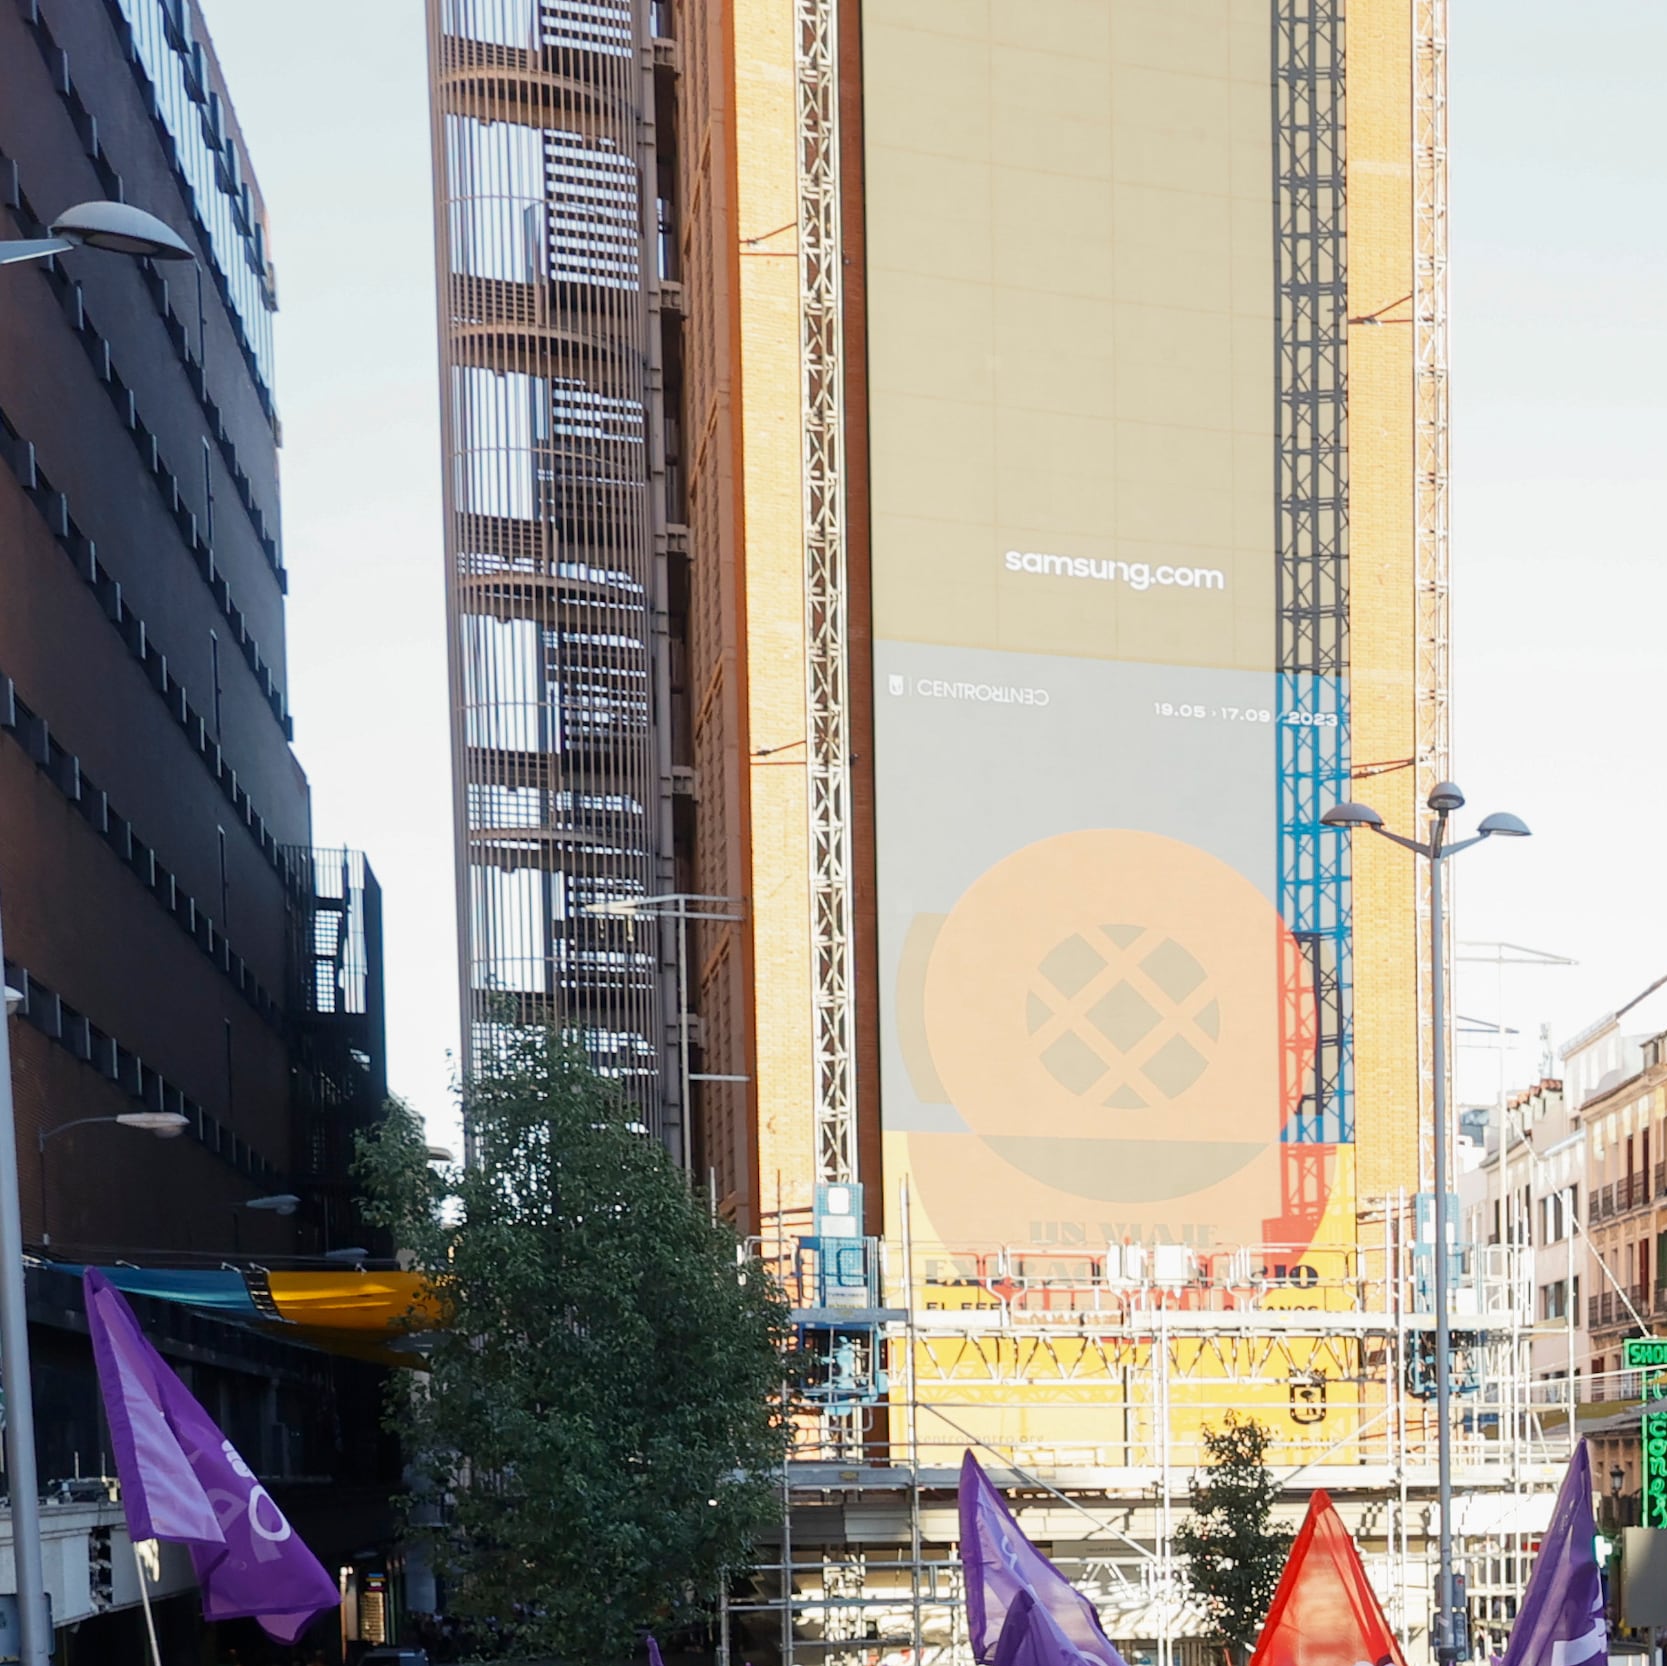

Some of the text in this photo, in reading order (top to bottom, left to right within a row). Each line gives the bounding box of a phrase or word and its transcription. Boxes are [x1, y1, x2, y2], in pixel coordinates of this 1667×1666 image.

[1004, 547, 1225, 591] samsung.com
[1154, 702, 1339, 727] 19.05 17.09 2023
